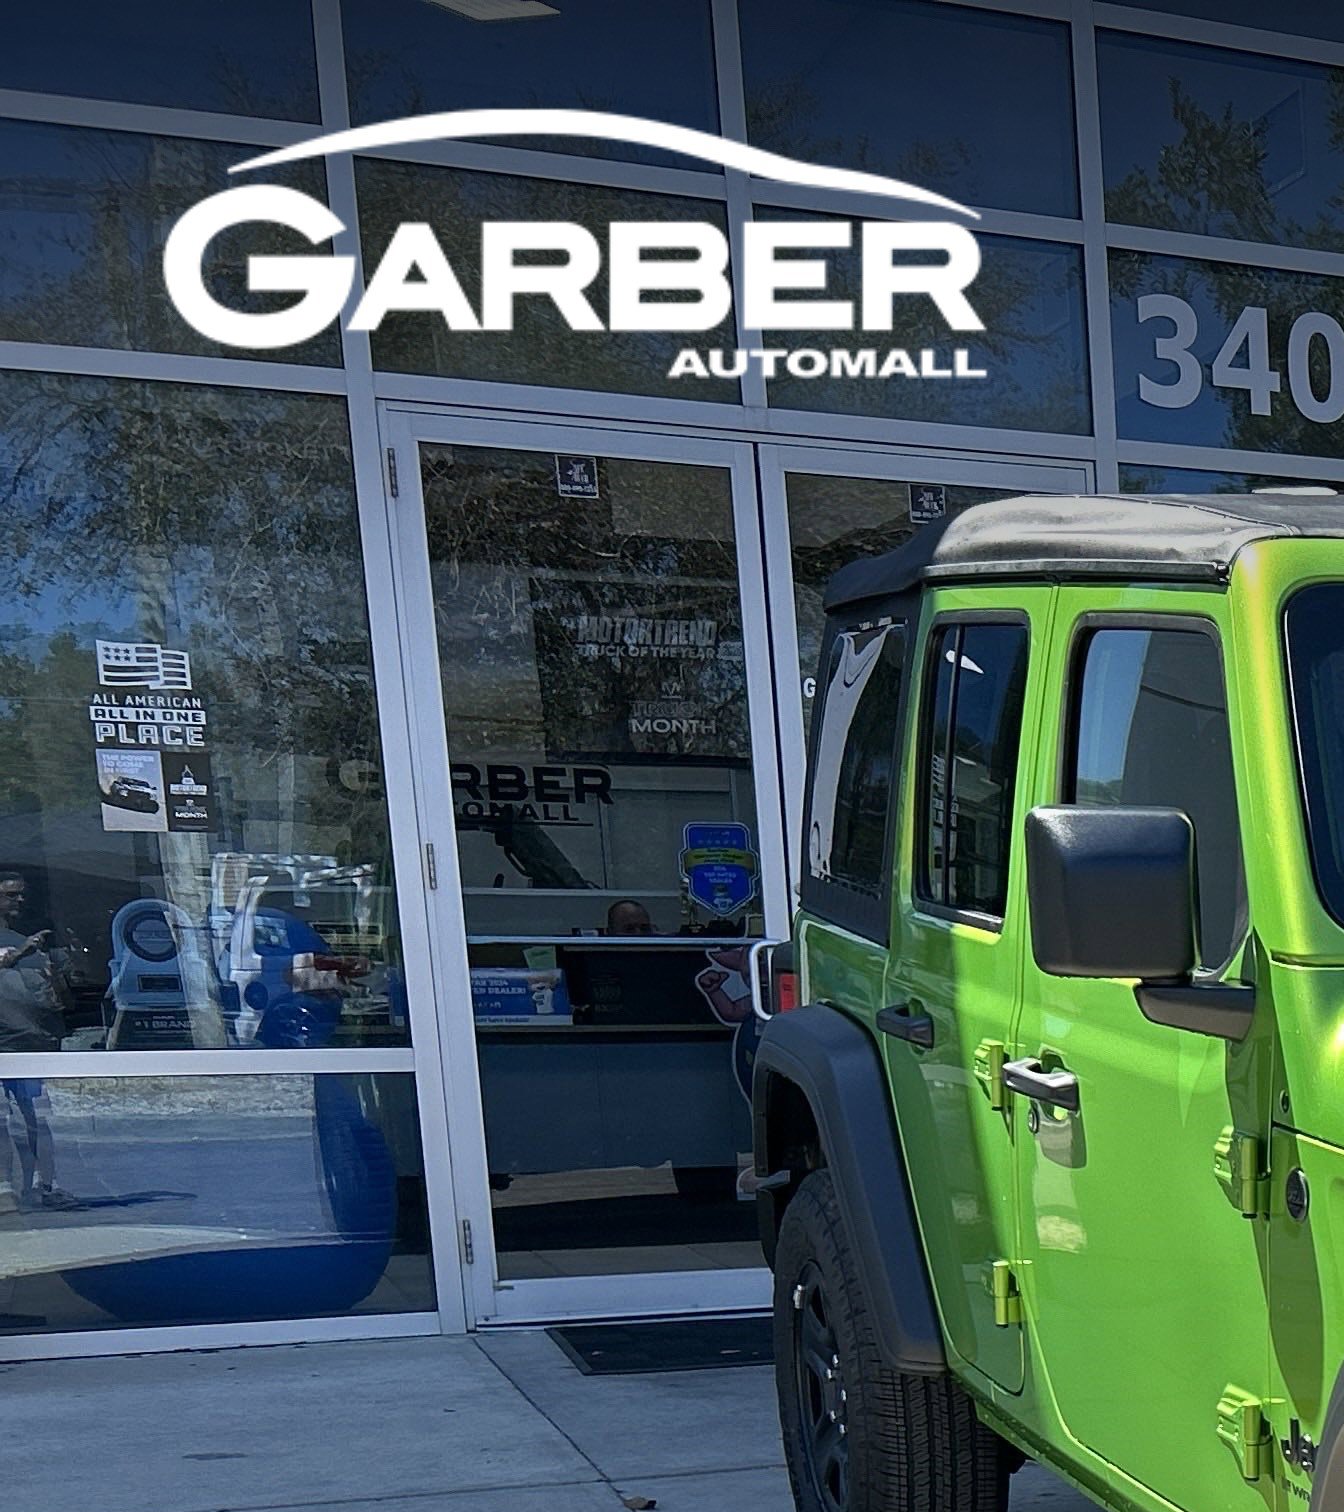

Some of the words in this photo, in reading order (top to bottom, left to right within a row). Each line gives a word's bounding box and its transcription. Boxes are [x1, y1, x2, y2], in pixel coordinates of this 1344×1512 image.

[628, 645, 648, 657] OF
[652, 646, 676, 658] THE
[92, 693, 120, 705] ALL
[125, 695, 202, 709] AMERICAN
[94, 709, 130, 720] ALL
[135, 710, 155, 721] IN
[162, 711, 202, 723] ONE
[631, 719, 717, 734] MONTH
[95, 723, 206, 747] PLACE
